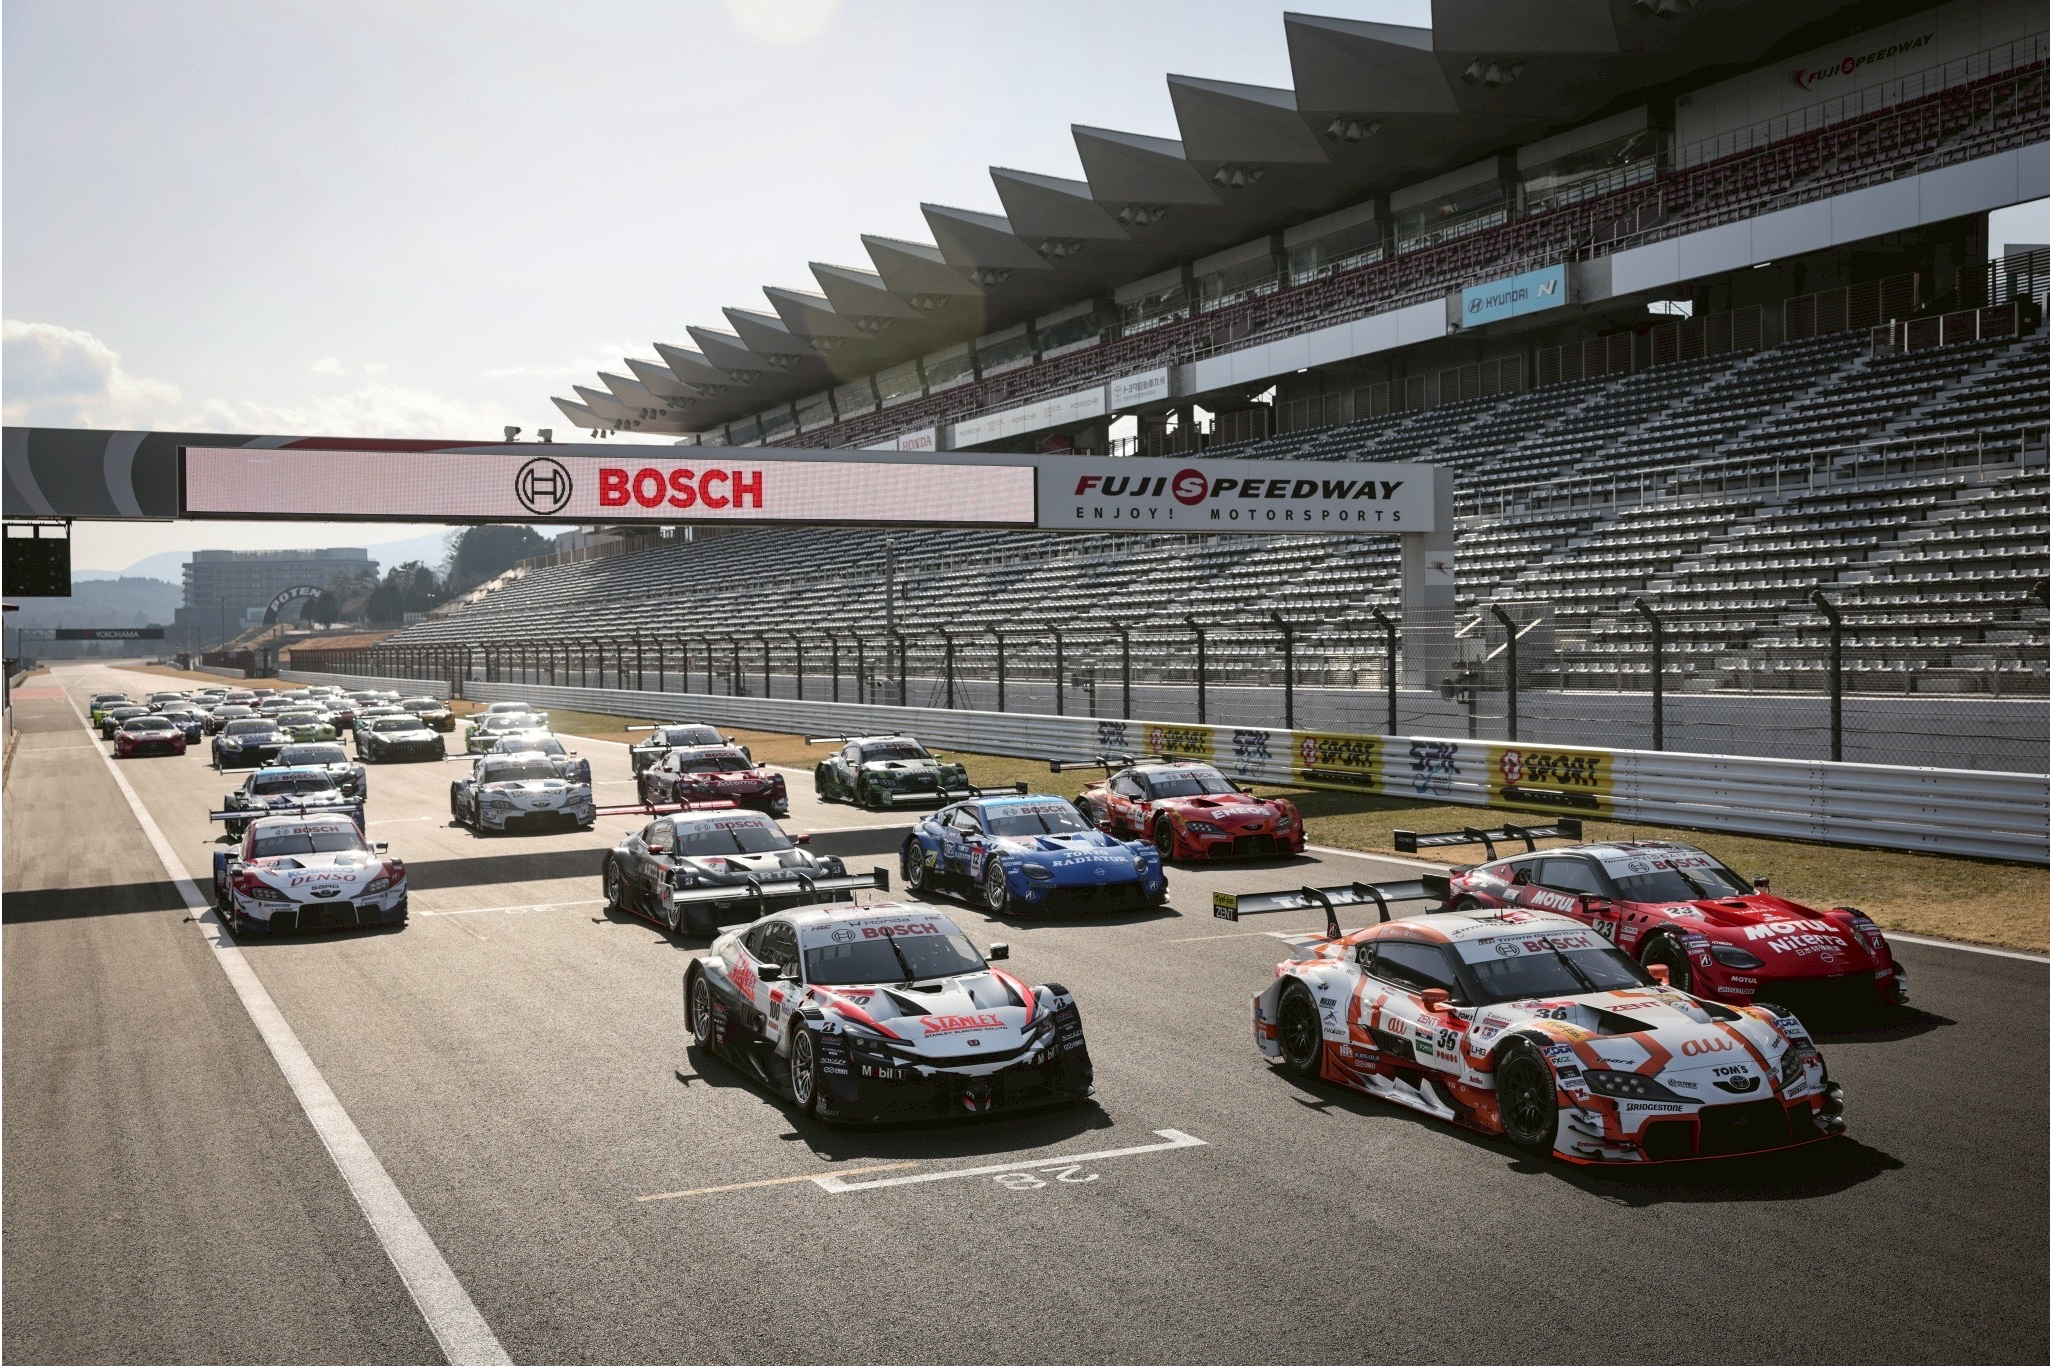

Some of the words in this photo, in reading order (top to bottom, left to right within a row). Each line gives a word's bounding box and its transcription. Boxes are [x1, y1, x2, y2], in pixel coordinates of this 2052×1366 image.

[1807, 65, 1840, 84] FUJI
[1841, 33, 1934, 76] SPEEDWAY
[1486, 287, 1528, 309] HYUNDAI
[1537, 279, 1558, 298] N
[1069, 397, 1099, 409] PORSCHE
[1011, 412, 1037, 424] PORSCHE
[902, 435, 933, 451] HONDA
[600, 468, 763, 508] BOSCH
[1074, 475, 1168, 497] FUJI
[1173, 471, 1405, 502] SPEEDWAY
[1076, 506, 1174, 520] ENJOY!
[1210, 507, 1402, 523] MOTORSPORTS
[270, 587, 322, 612] POTEN
[95, 630, 140, 639] YOKOHAMA
[717, 779, 758, 787] Astemo
[1180, 772, 1215, 780] BOSCH
[1020, 805, 1068, 814] BOSCH
[1211, 806, 1271, 820] ENEOS
[293, 826, 340, 834] BOSCH
[714, 820, 765, 830] BOSCH
[1063, 849, 1109, 859] TOKYO
[1052, 855, 1129, 868] RADIATOR
[1651, 857, 1712, 870] BOSCH
[288, 867, 355, 878] KOBELCO
[747, 870, 800, 881] ARTA
[291, 873, 357, 887] DENSO
[1531, 890, 1576, 912] MOTUL
[1216, 906, 1234, 920] ZENT
[1667, 906, 1694, 914] 23
[864, 917, 911, 926] Honda
[862, 923, 939, 939] BOSCH
[1597, 921, 1614, 938] 23
[1743, 920, 1840, 940] MOTUL
[1498, 935, 1534, 943] TOYOTA
[1522, 936, 1595, 953] BOSCH
[1767, 934, 1849, 953] Niterra
[769, 1000, 780, 1020] 100
[1535, 1006, 1568, 1020] 36
[1606, 1000, 1660, 1012] ZENT
[919, 1013, 1006, 1034] STANLEY
[1417, 1013, 1438, 1026] ZENT
[1458, 1012, 1473, 1021] TOM'S
[924, 1031, 952, 1039] STANLEY
[954, 1027, 984, 1035] ELECTRIC
[1388, 1017, 1407, 1035] au
[1437, 1028, 1459, 1051] 36
[1471, 1045, 1487, 1056] LHG
[1681, 1037, 1733, 1057] au
[1436, 1049, 1458, 1063] PONOS
[1593, 1057, 1637, 1066] spark
[862, 1064, 893, 1079] Mobil
[1712, 1064, 1749, 1077] TOM'S
[1626, 1102, 1683, 1112] BRIDGESTONE
[993, 1164, 1100, 1190] 28
